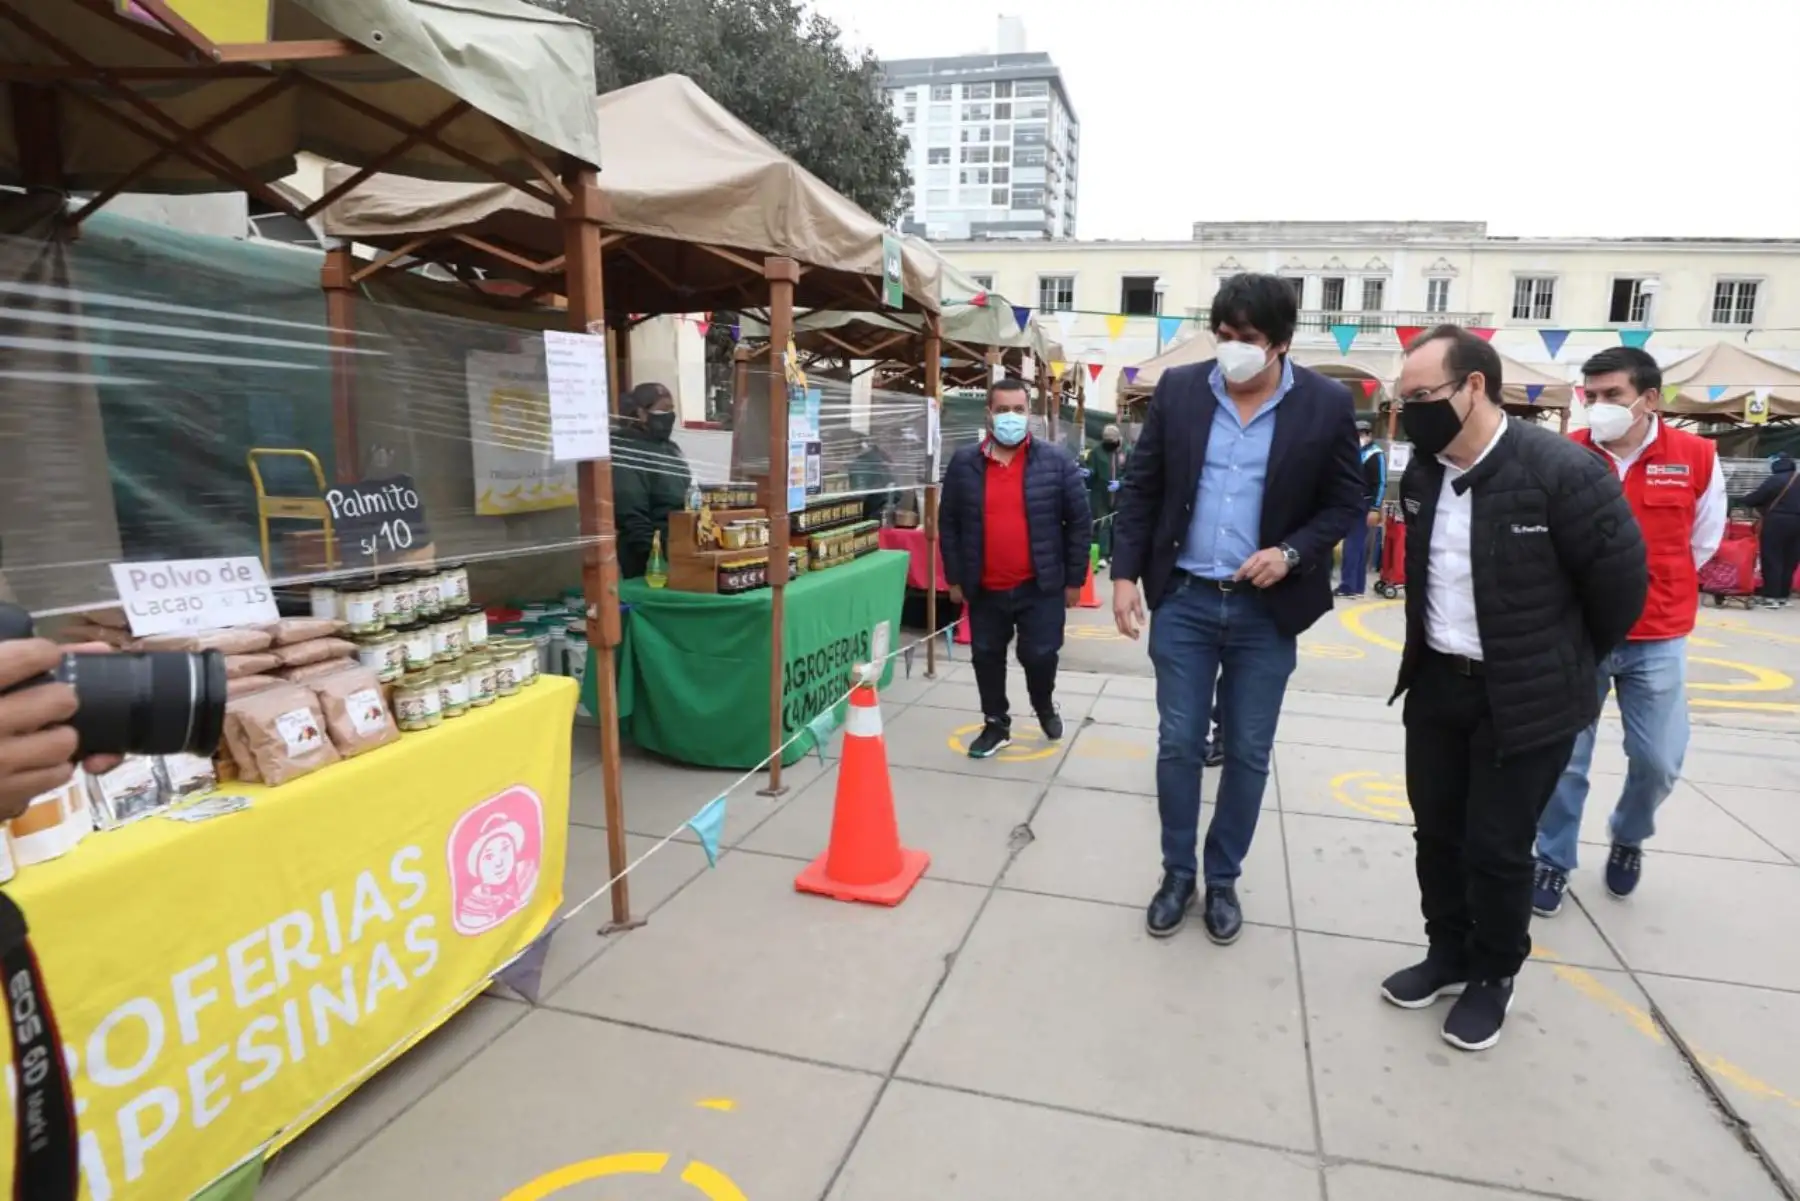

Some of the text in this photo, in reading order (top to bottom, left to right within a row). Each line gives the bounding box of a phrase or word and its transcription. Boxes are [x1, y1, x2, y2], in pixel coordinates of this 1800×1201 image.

[325, 483, 419, 519] Palmito
[128, 562, 252, 592] Polvo de
[783, 628, 869, 697] AGROFERIAS
[783, 672, 851, 733] CAMPESIN
[9, 969, 43, 1044] EOS
[22, 1045, 49, 1087] 6D
